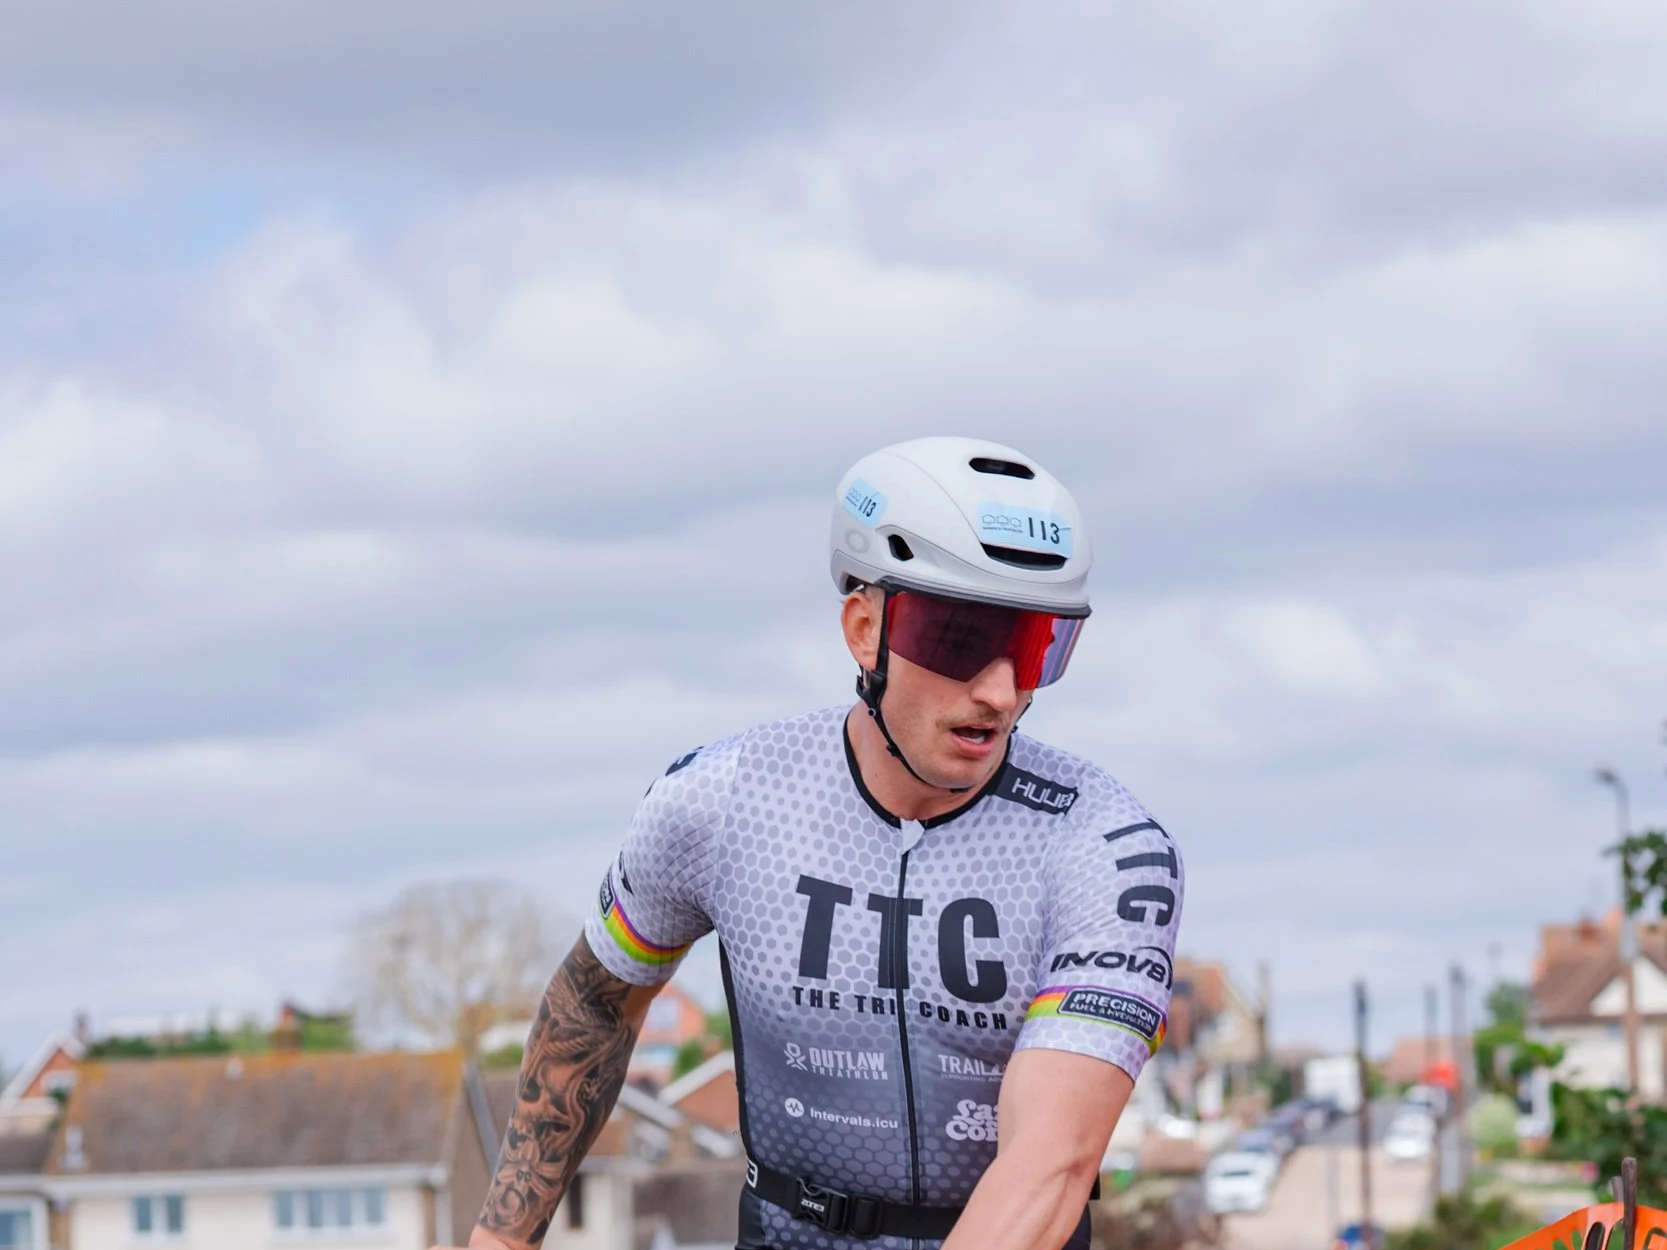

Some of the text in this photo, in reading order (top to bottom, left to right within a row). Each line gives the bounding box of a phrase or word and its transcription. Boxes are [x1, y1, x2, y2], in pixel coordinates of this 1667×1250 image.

[858, 496, 877, 517] 113
[1028, 517, 1060, 545] 113
[1011, 777, 1075, 808] HUUB
[796, 874, 1008, 1003] TTC
[792, 986, 1008, 1030] THE TRI COACH
[1070, 1002, 1096, 1013] FUEL
[1073, 993, 1156, 1026] PRECISION
[808, 1047, 885, 1071] OUTLAW
[812, 1065, 888, 1080] TRIATHLON
